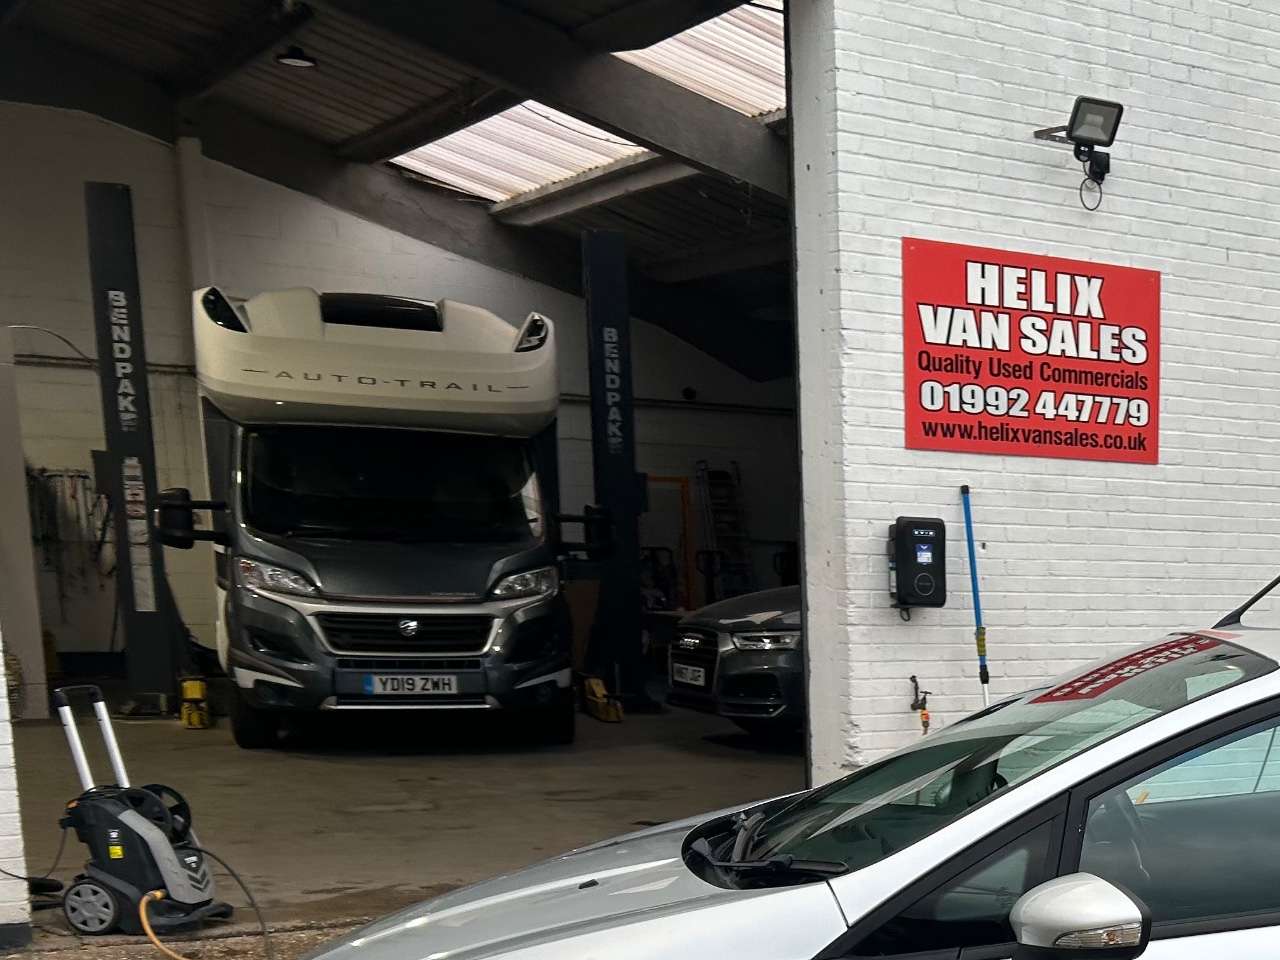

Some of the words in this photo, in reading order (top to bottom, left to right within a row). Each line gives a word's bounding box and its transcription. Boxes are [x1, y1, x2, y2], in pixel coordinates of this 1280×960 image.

[965, 261, 1104, 319] HELIX
[107, 290, 138, 413] BENDPAK
[917, 303, 1010, 352] VAN
[1018, 315, 1148, 364] SALES
[274, 369, 504, 393] AUTO-TRAIL
[603, 327, 624, 437] BENDPAK
[917, 350, 982, 380] Quality
[989, 357, 1033, 381] Used
[1039, 361, 1148, 391] Commercials
[919, 379, 1030, 418] 01992
[1034, 390, 1149, 428] 447779
[921, 420, 1147, 452] www.helixvansales.co.uk
[379, 677, 416, 692] YD19
[421, 677, 452, 692] ZWH
